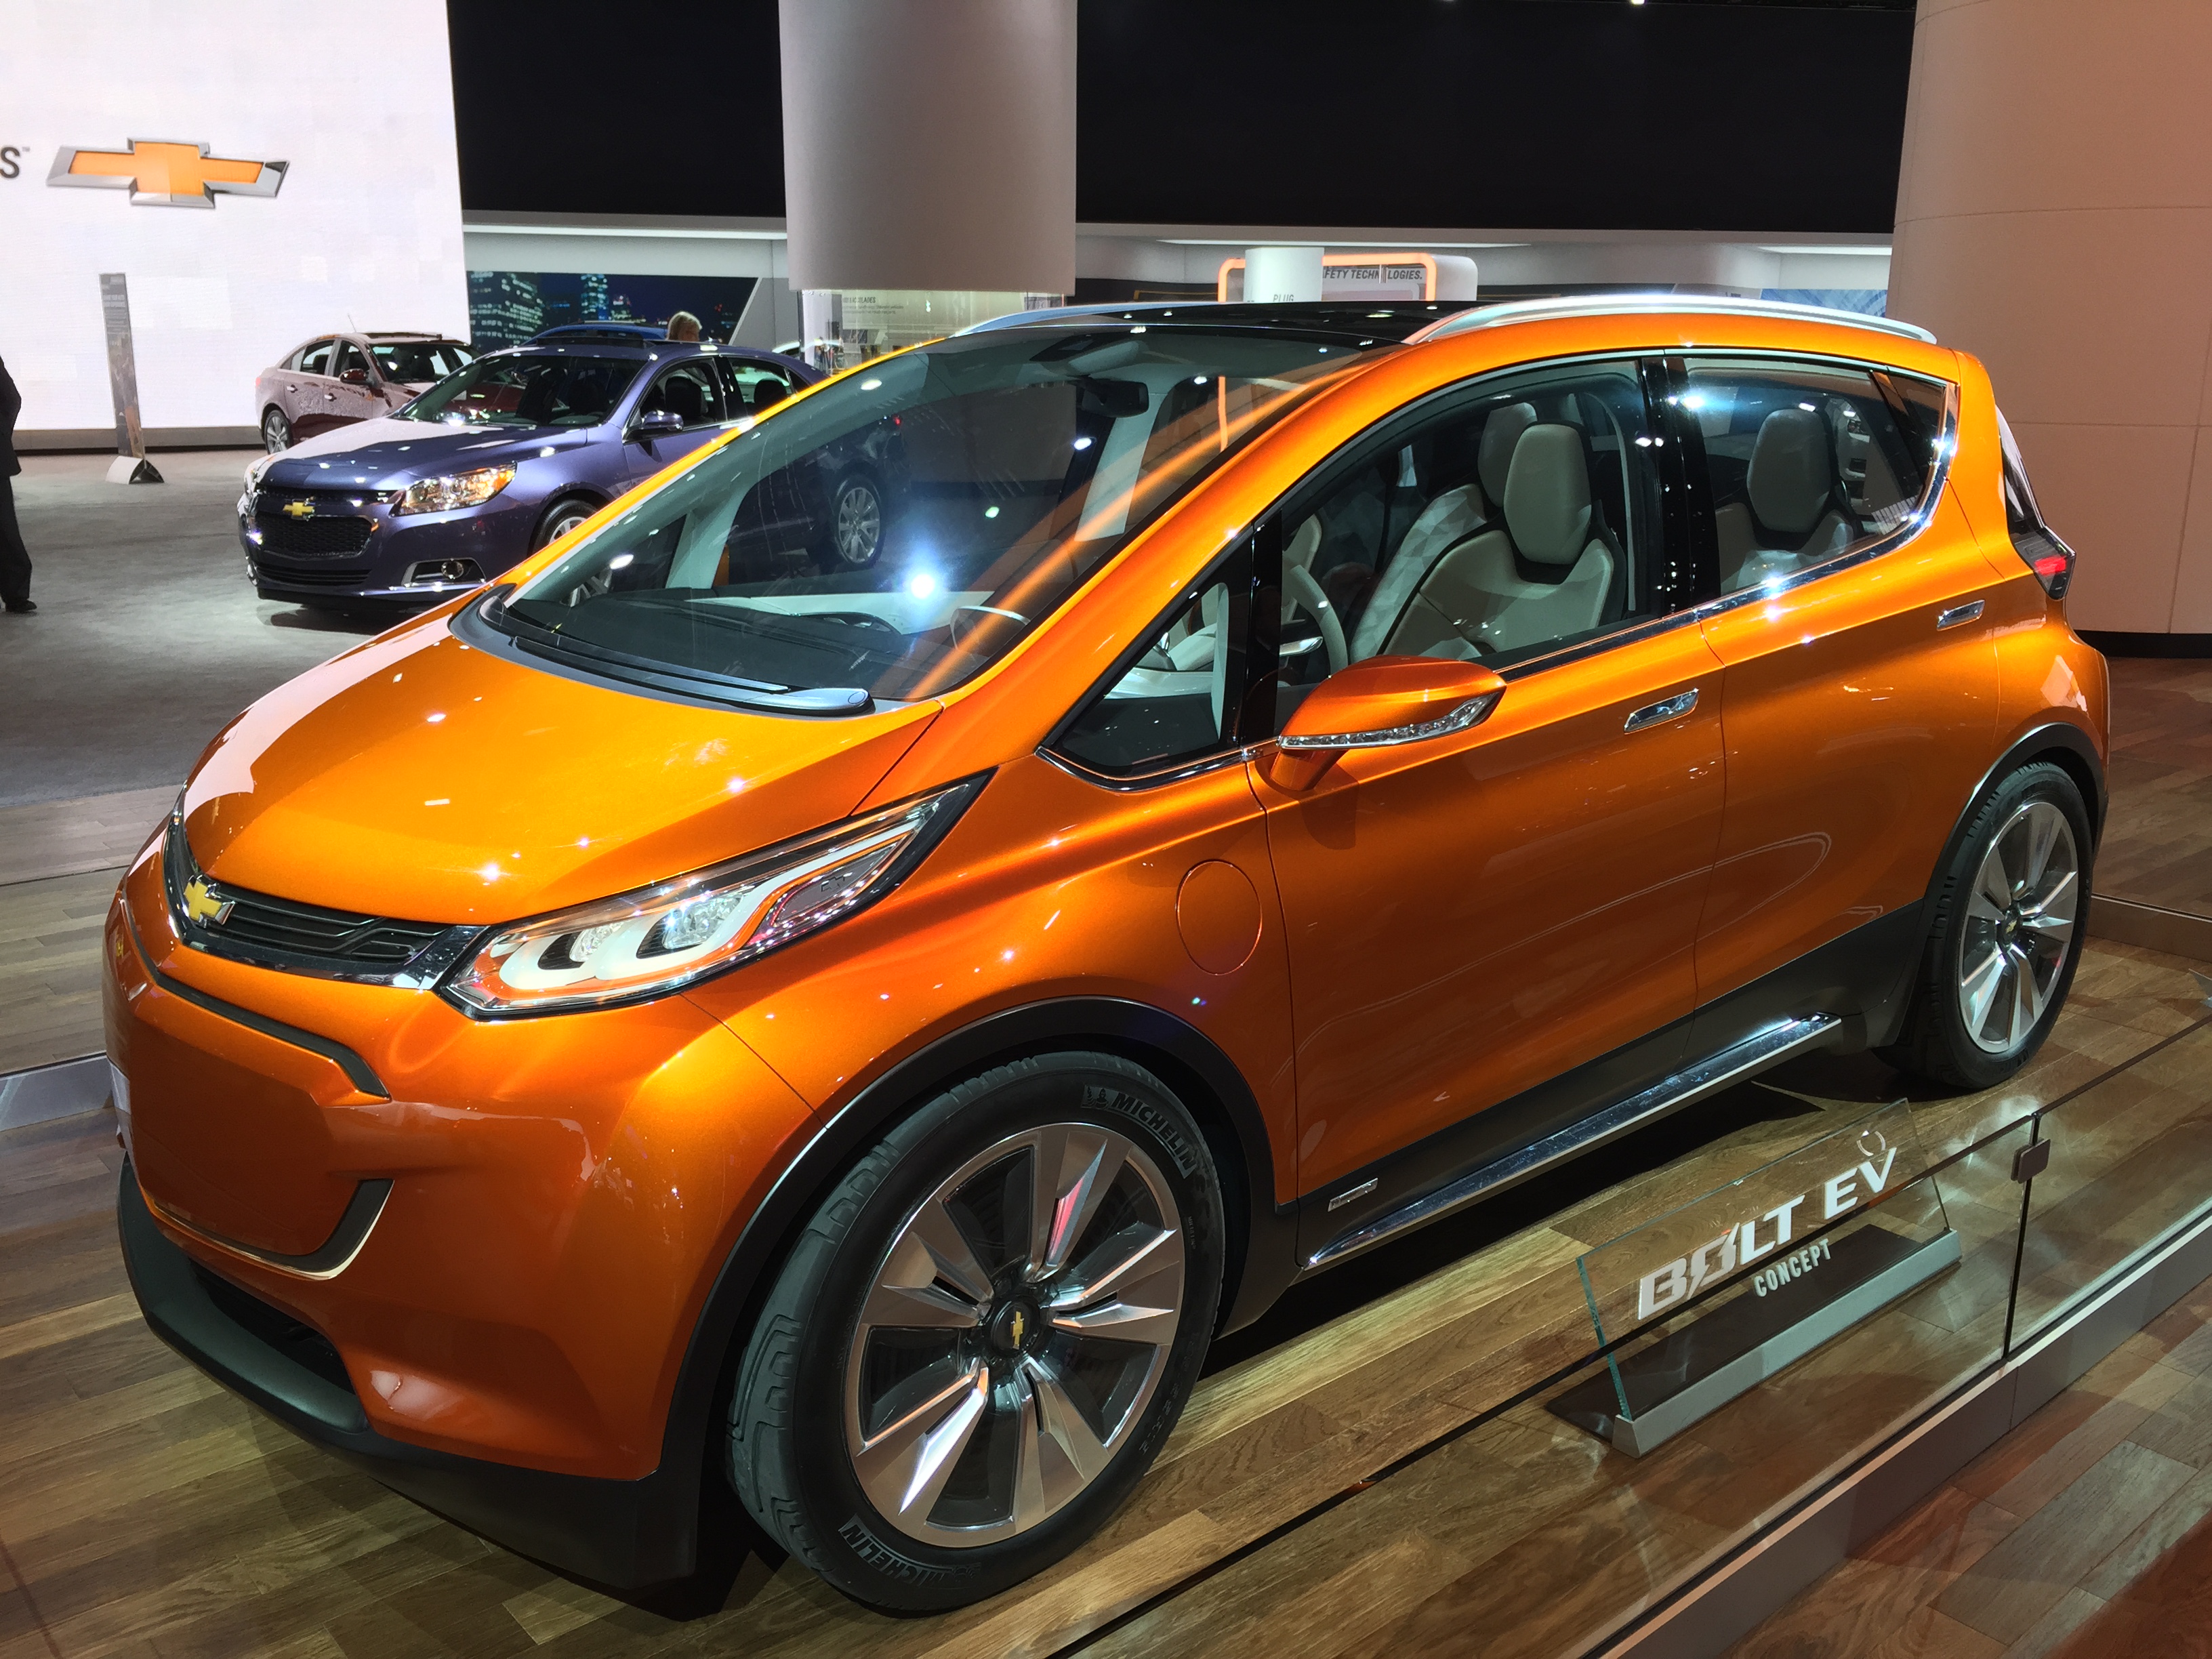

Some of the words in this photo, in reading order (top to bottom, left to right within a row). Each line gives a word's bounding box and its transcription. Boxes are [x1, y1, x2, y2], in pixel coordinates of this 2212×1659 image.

[1323, 269, 1347, 279] FETY
[1351, 269, 1422, 279] TECHNLOGIES.
[1112, 1092, 1197, 1169] MICHELIN
[1637, 1195, 1805, 1320] BOLT
[1824, 1147, 1897, 1220] EV
[1754, 1238, 1831, 1297] CONCEPT
